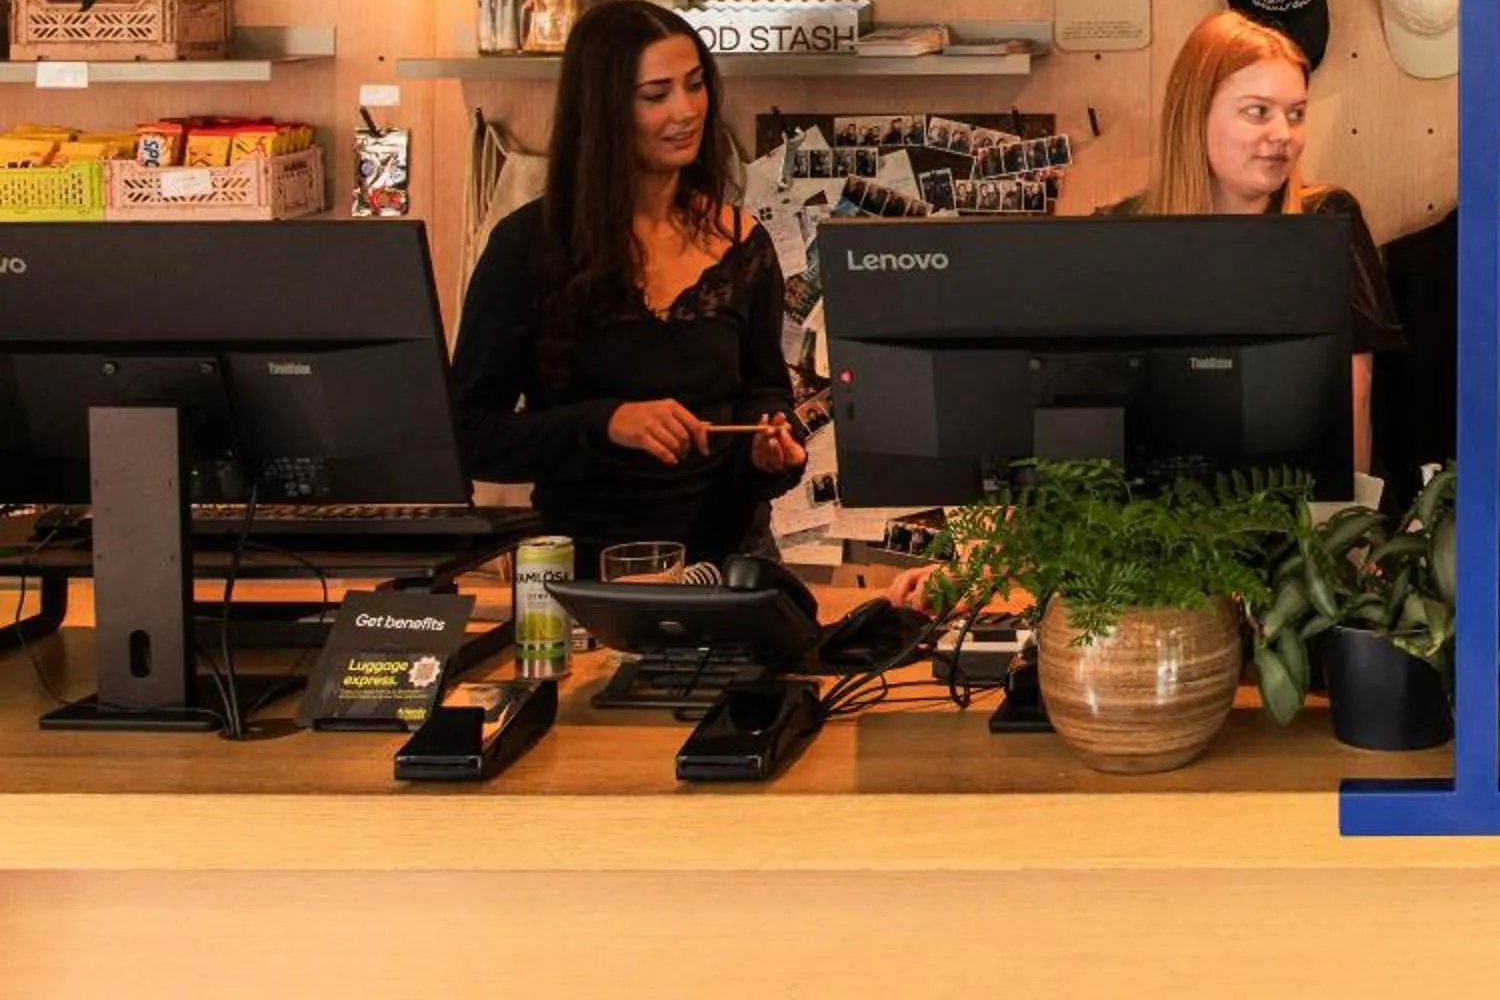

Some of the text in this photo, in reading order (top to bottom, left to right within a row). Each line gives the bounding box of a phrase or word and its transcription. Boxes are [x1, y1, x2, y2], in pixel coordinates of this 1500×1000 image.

[846, 249, 950, 271] Lenovo
[514, 570, 570, 584] AMLÖS
[355, 613, 446, 631] Get benefits
[347, 658, 409, 673] Luggage
